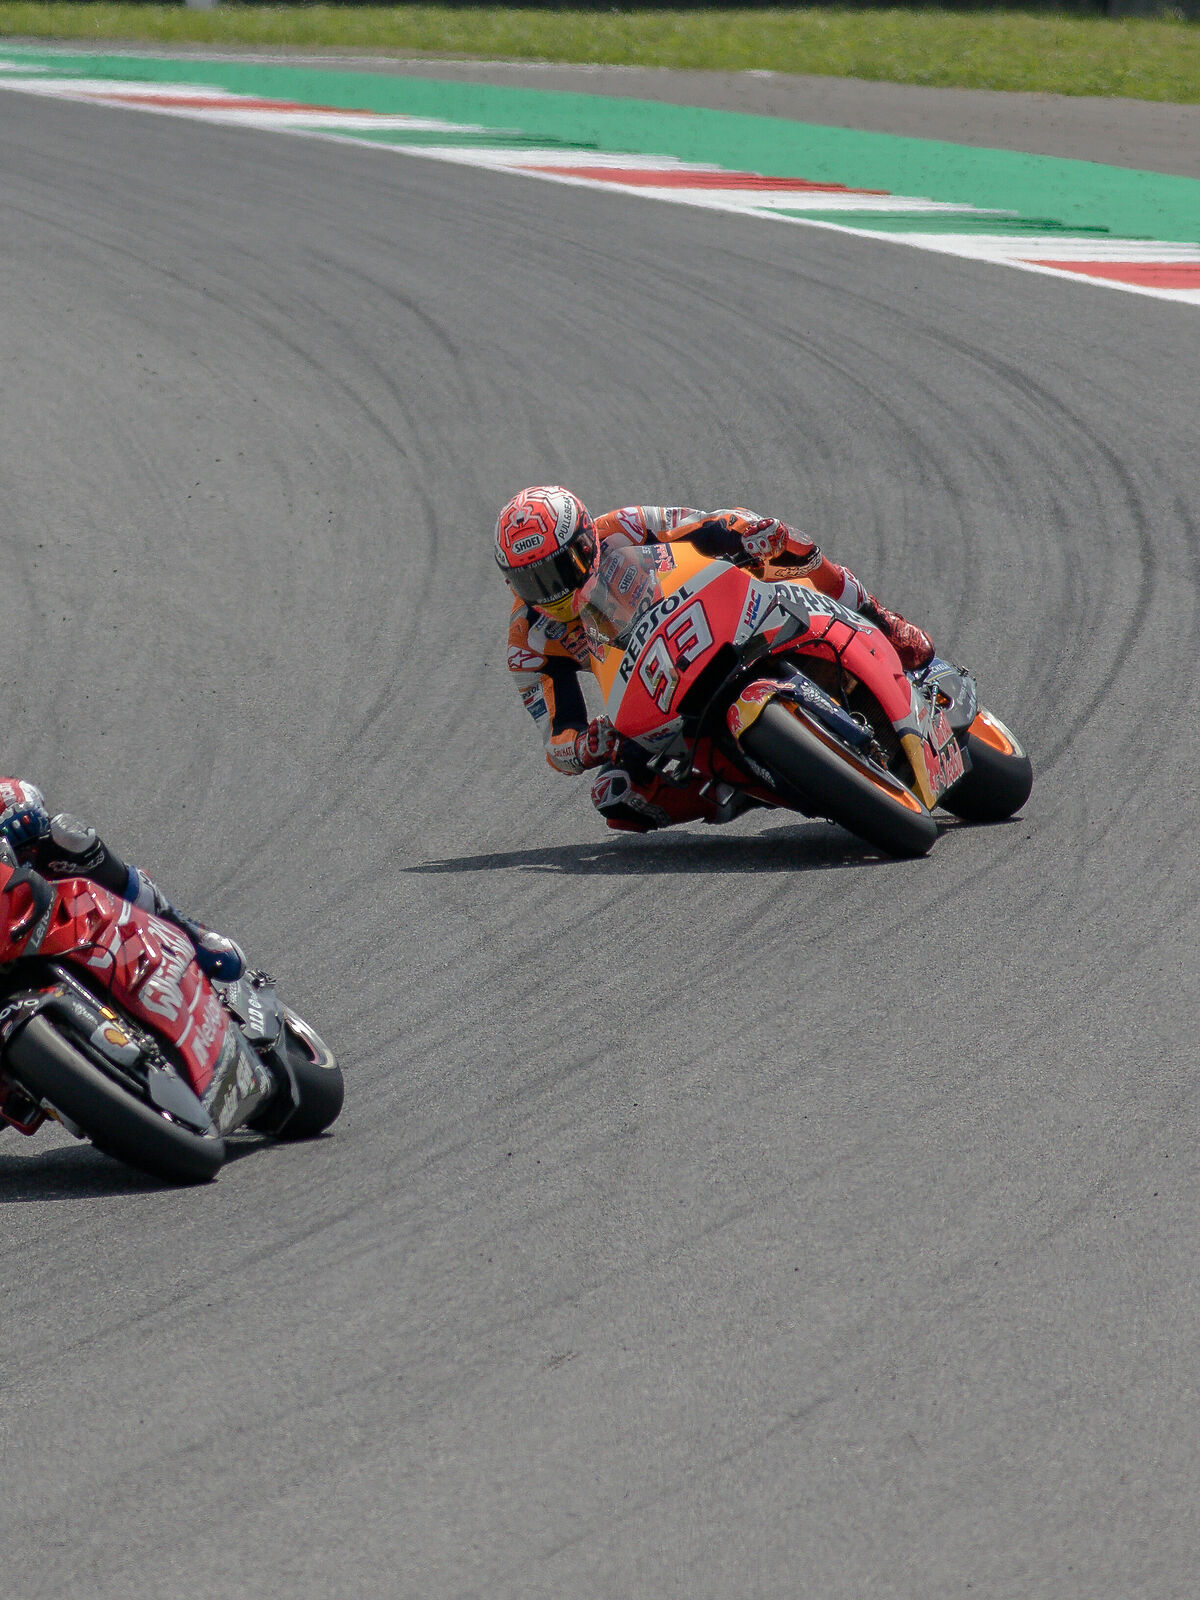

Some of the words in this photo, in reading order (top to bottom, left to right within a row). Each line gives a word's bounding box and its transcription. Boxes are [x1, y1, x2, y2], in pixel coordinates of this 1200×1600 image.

[514, 536, 541, 553] SHOEI
[620, 567, 636, 592] SHOEI
[744, 589, 761, 629] HRC
[618, 585, 695, 684] REPSOL
[638, 599, 714, 715] 93
[522, 683, 541, 699] PSOL
